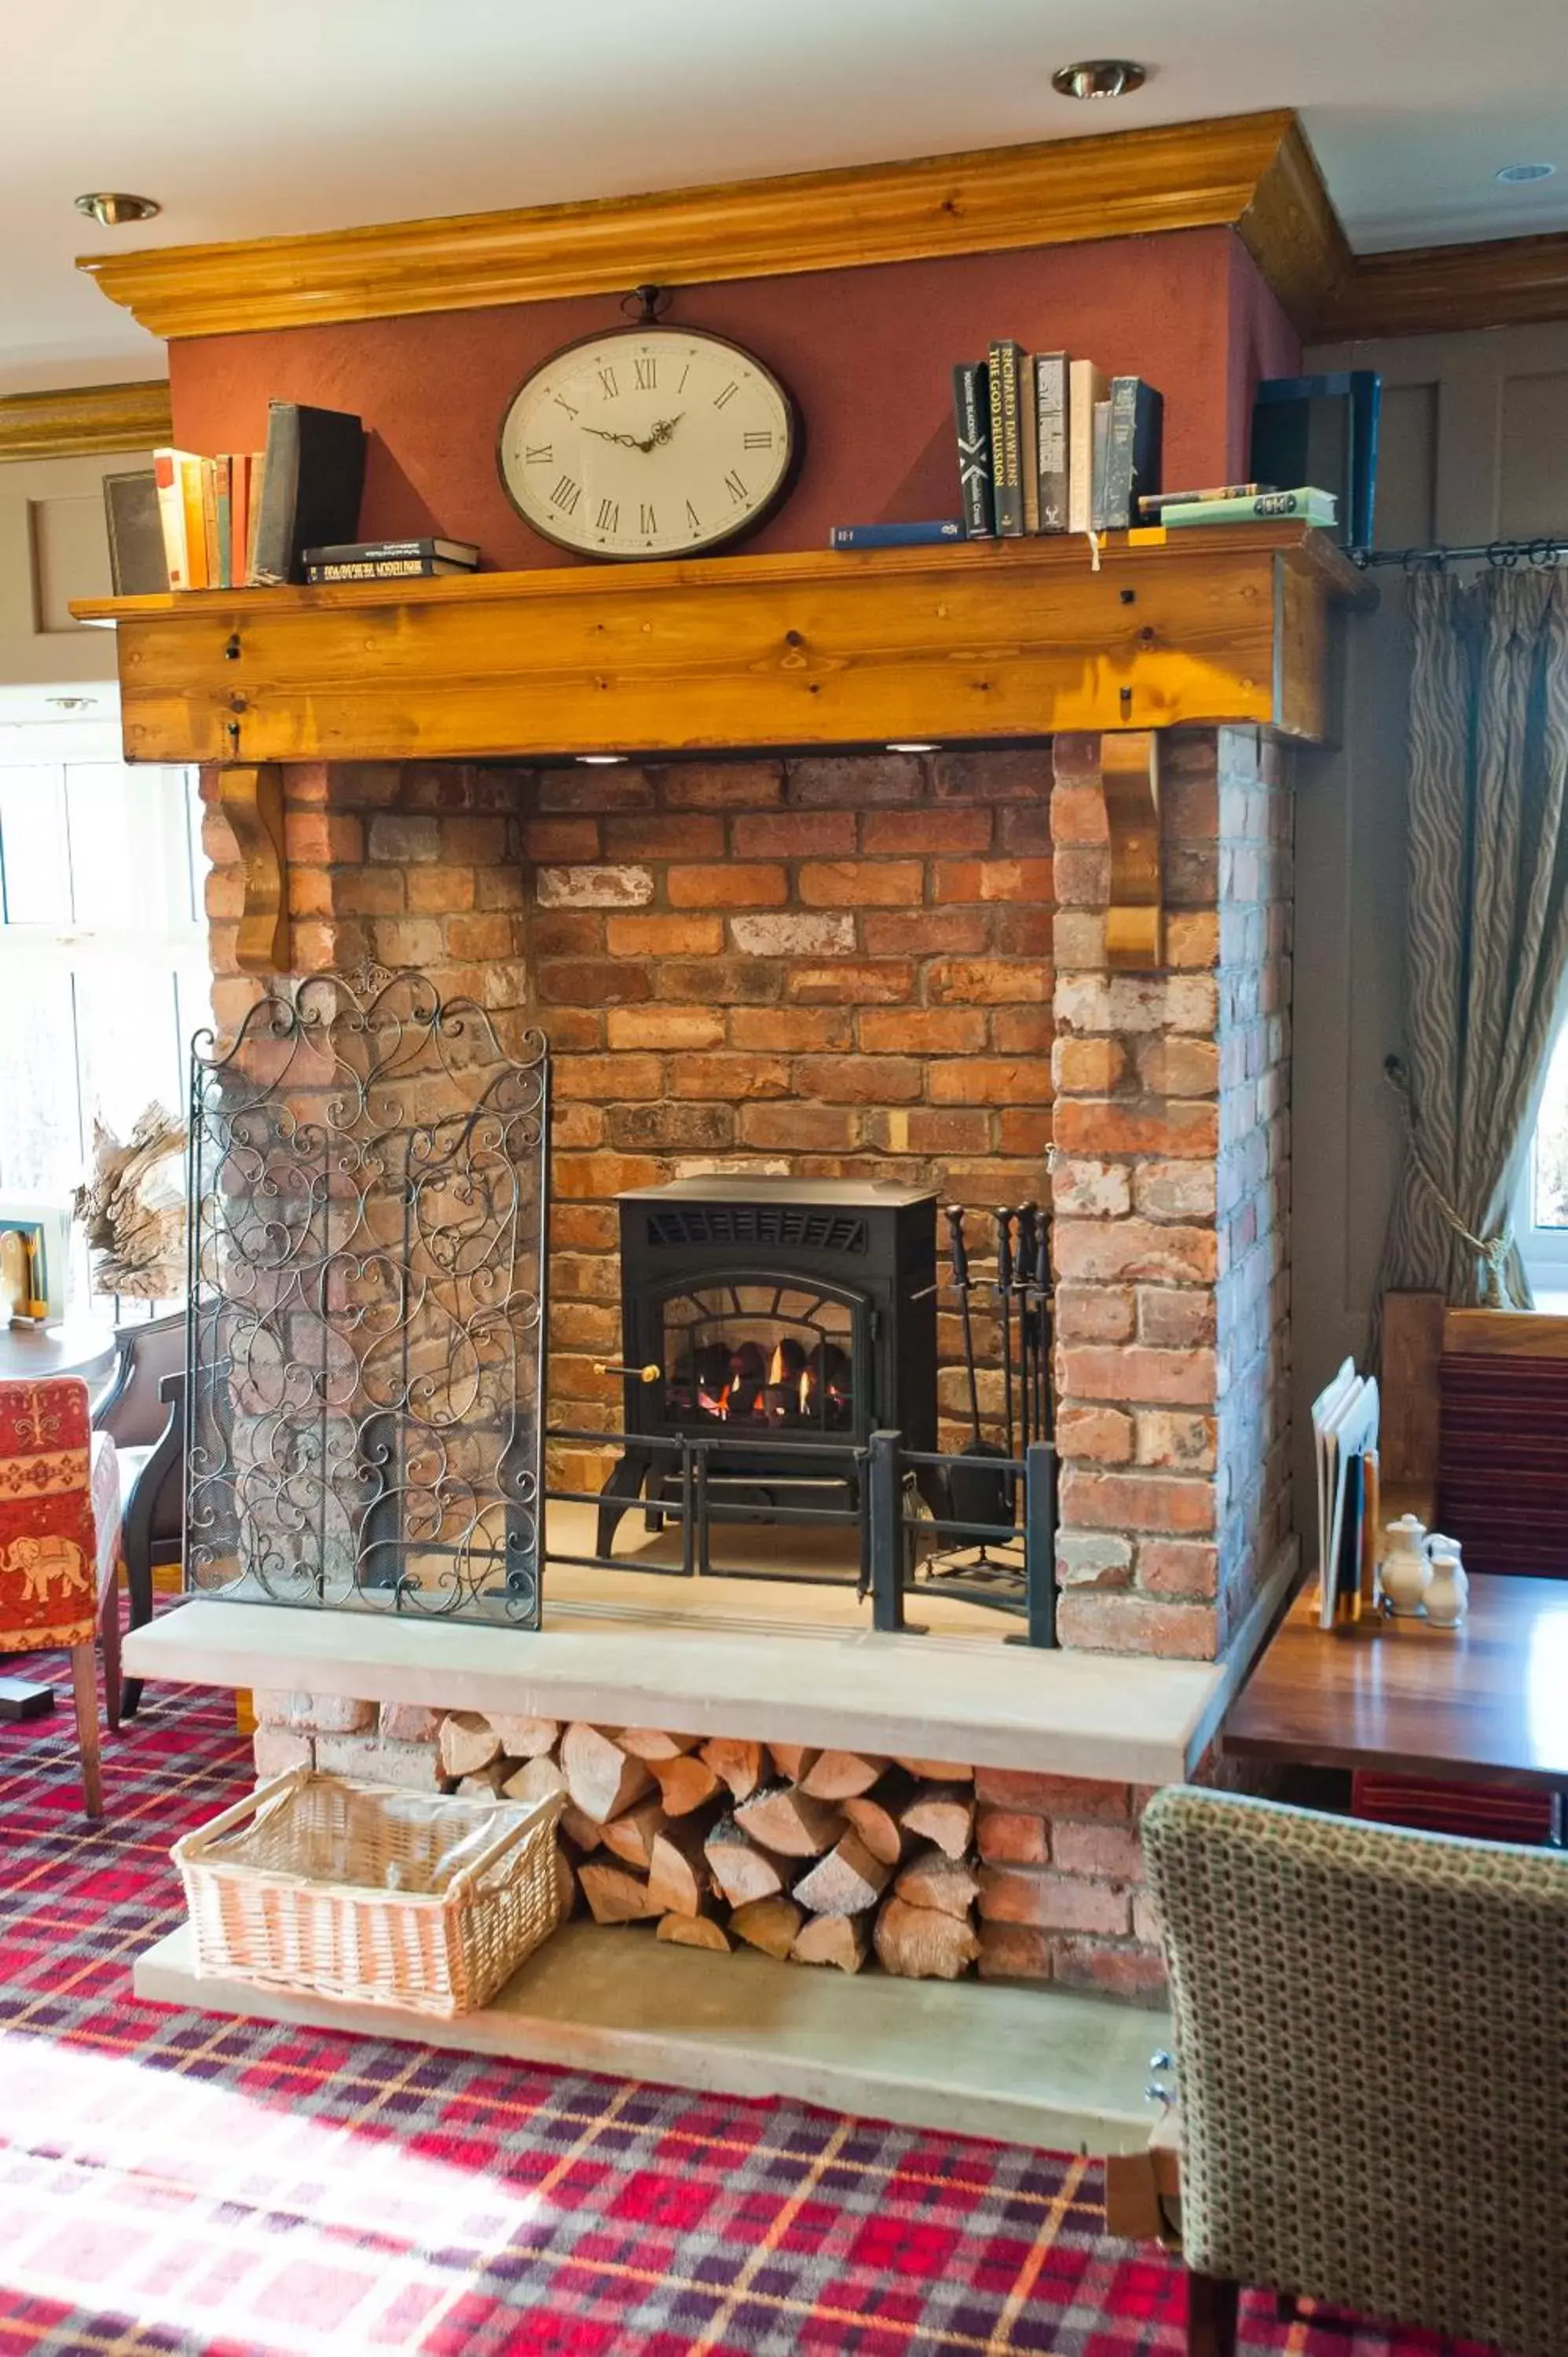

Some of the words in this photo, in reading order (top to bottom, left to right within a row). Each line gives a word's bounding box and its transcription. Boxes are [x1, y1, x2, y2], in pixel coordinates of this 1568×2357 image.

[633, 359, 657, 390] XII
[989, 348, 1000, 376] THE
[598, 367, 618, 401] XI
[713, 381, 738, 409] II
[991, 379, 1002, 413] GOD
[1002, 348, 1015, 415] RICHARD
[554, 394, 579, 421] X
[526, 445, 553, 464] IX
[743, 431, 772, 450] III
[992, 416, 1004, 486] DELUSION
[1005, 420, 1018, 486] DAWKINS
[550, 475, 582, 515] VIII
[724, 470, 749, 504] IV
[596, 498, 619, 533] VII
[640, 503, 658, 534] VI
[686, 498, 701, 529] V
